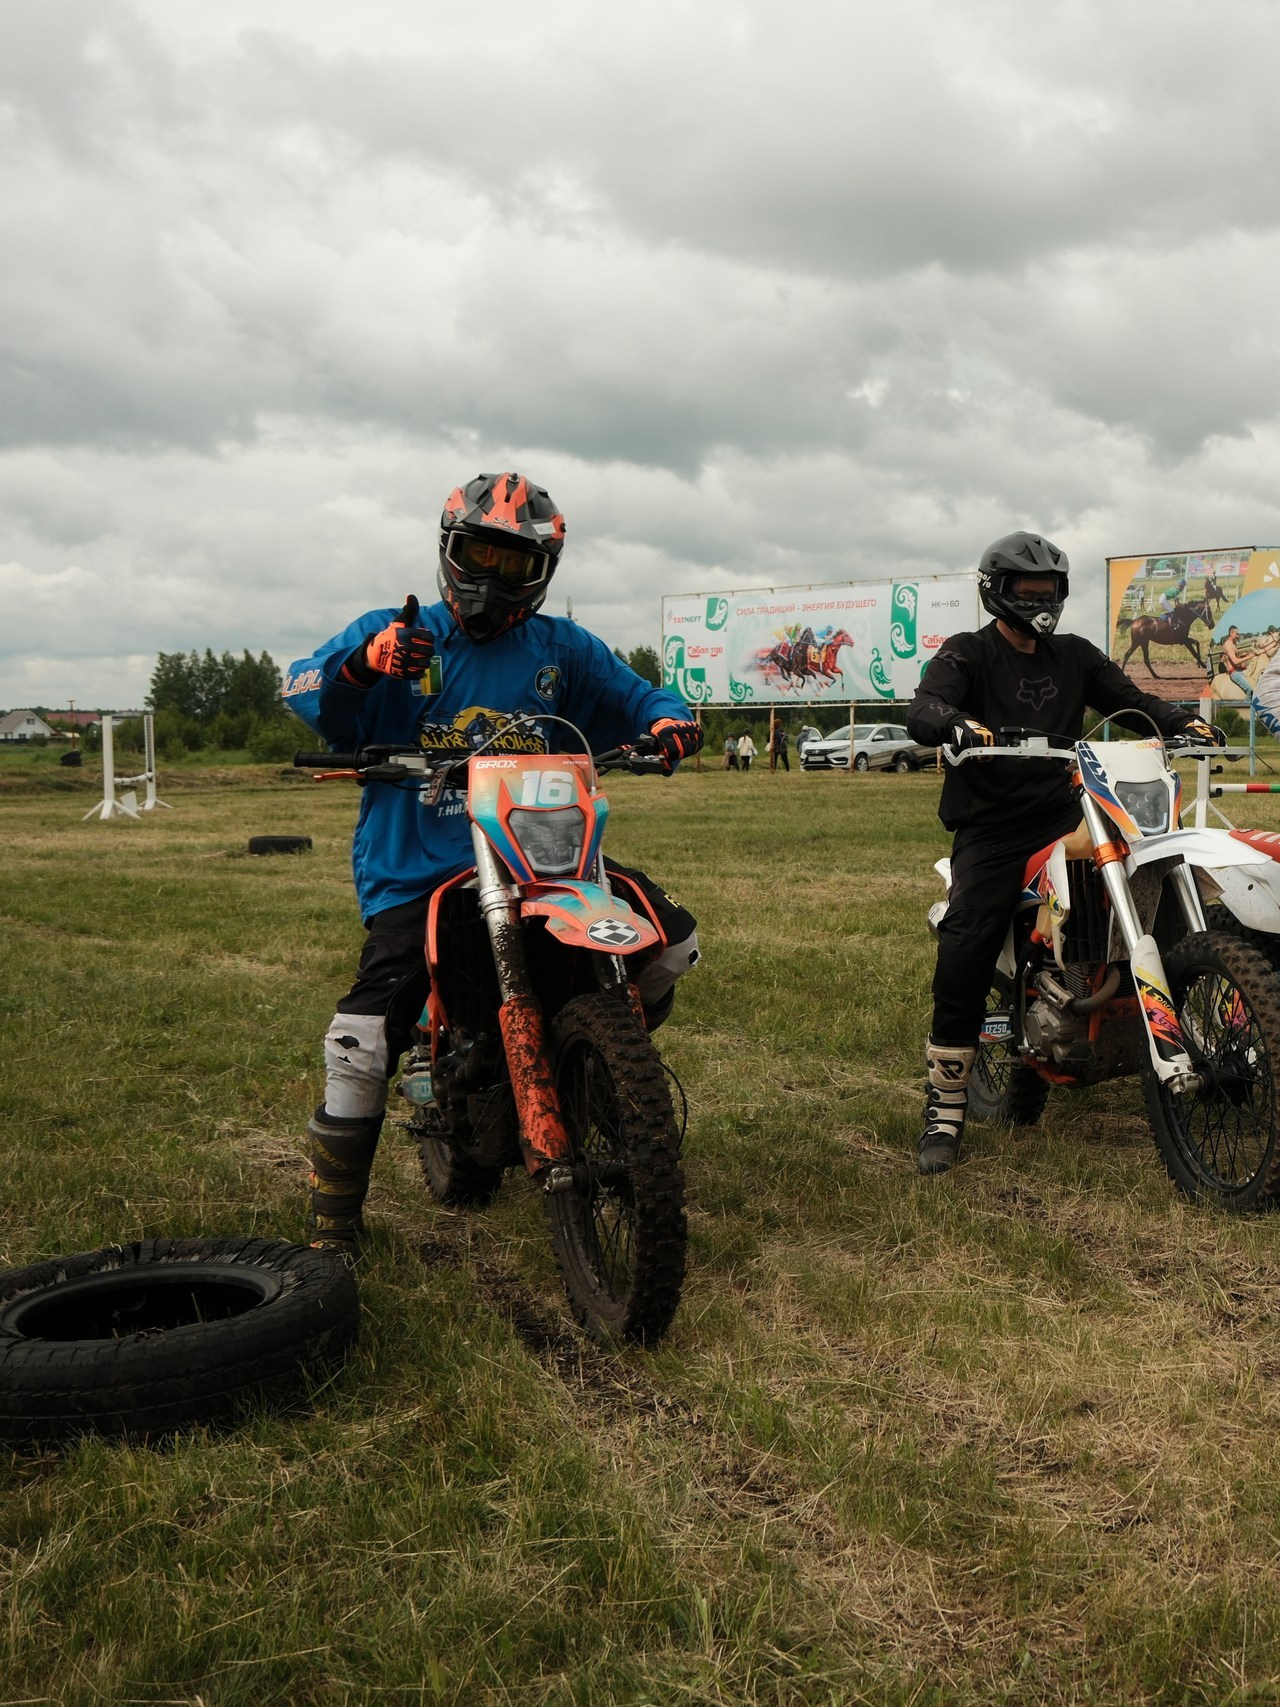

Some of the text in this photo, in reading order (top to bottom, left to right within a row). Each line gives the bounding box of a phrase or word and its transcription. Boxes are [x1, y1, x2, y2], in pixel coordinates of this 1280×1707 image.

[736, 608, 755, 616] СИЛА
[757, 603, 795, 615] ТРАДИЦИЙ
[801, 602, 834, 612] ЭНЕРГИЯ
[836, 599, 877, 610] БУДУЩЕГО
[922, 635, 948, 648] Саба
[687, 646, 709, 658] Сабан
[475, 760, 518, 769] GROX
[521, 770, 573, 806] 16
